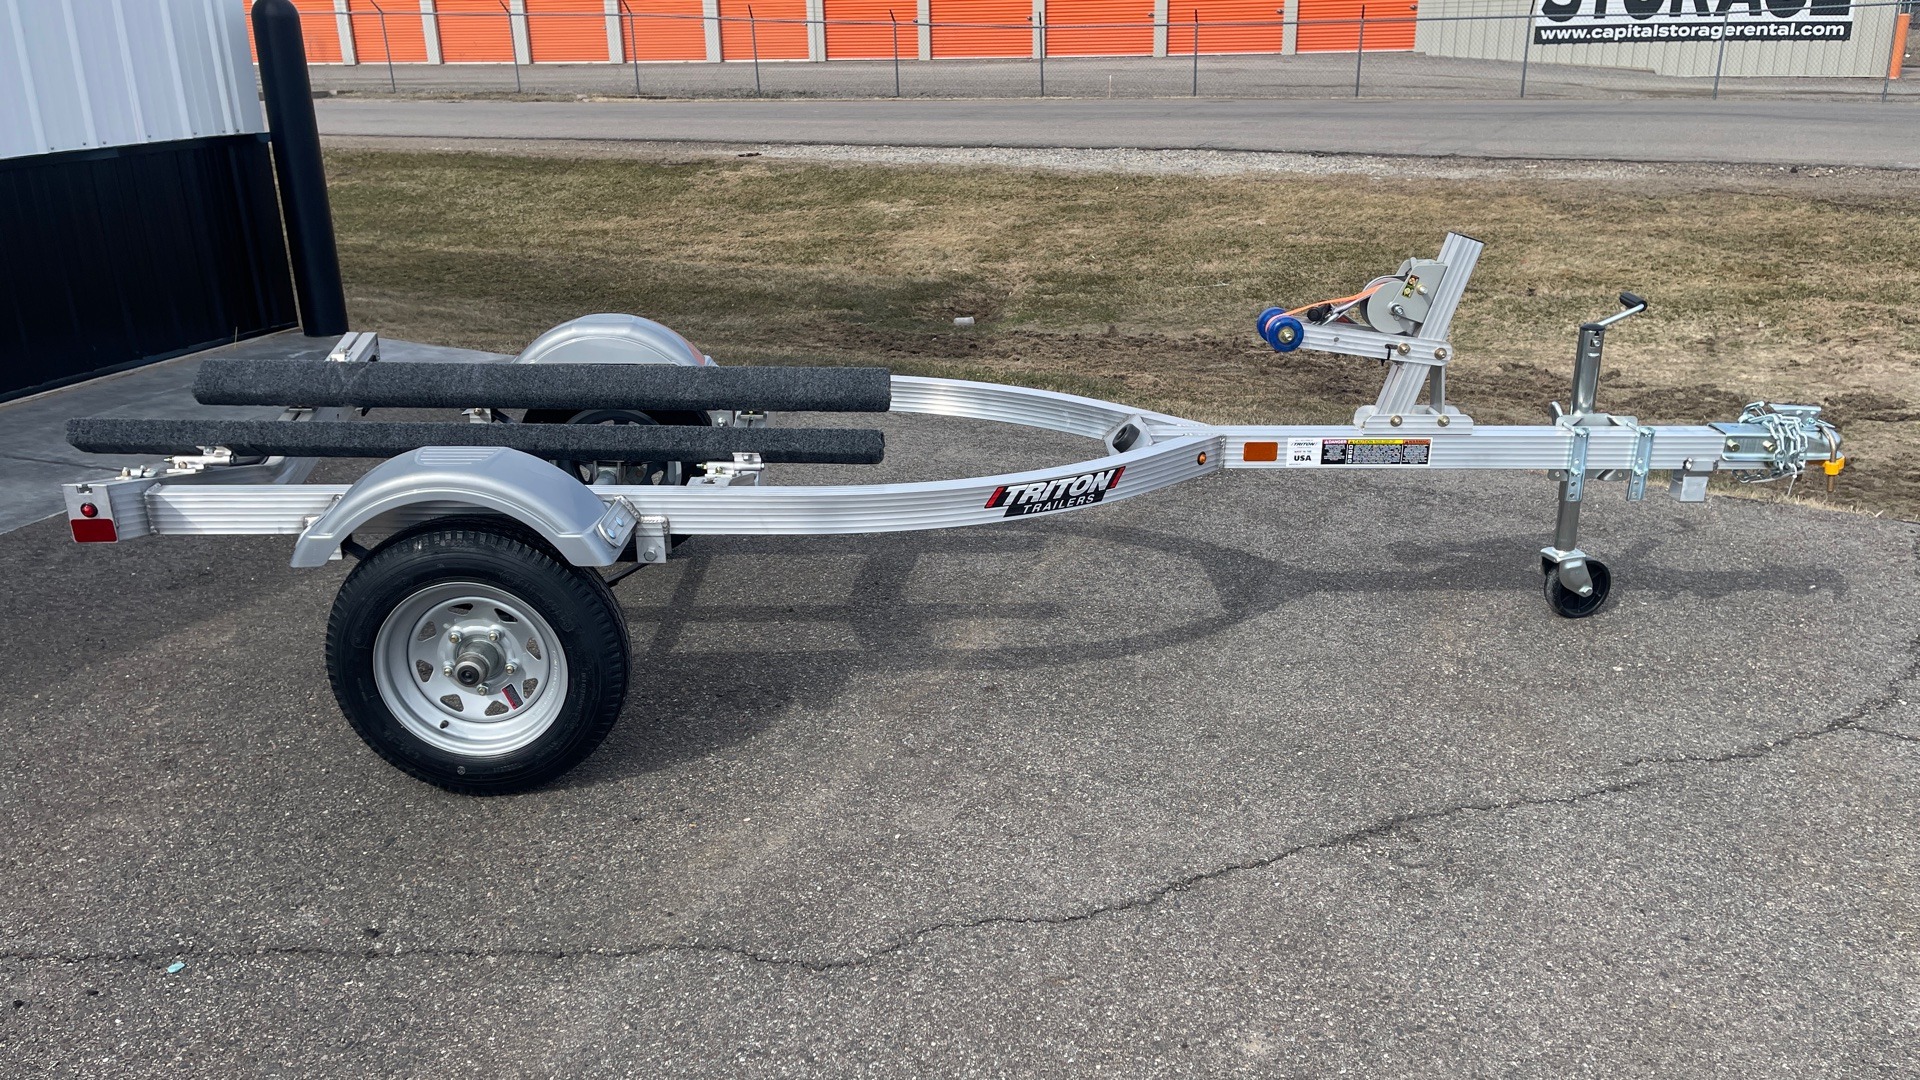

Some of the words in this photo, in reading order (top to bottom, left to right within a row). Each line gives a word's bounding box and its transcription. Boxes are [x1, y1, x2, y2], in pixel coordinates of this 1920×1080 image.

[1541, 23, 1844, 41] www.capitalstoragerental.com
[1003, 469, 1115, 506] TRITON
[1023, 494, 1095, 514] TRAILERS
